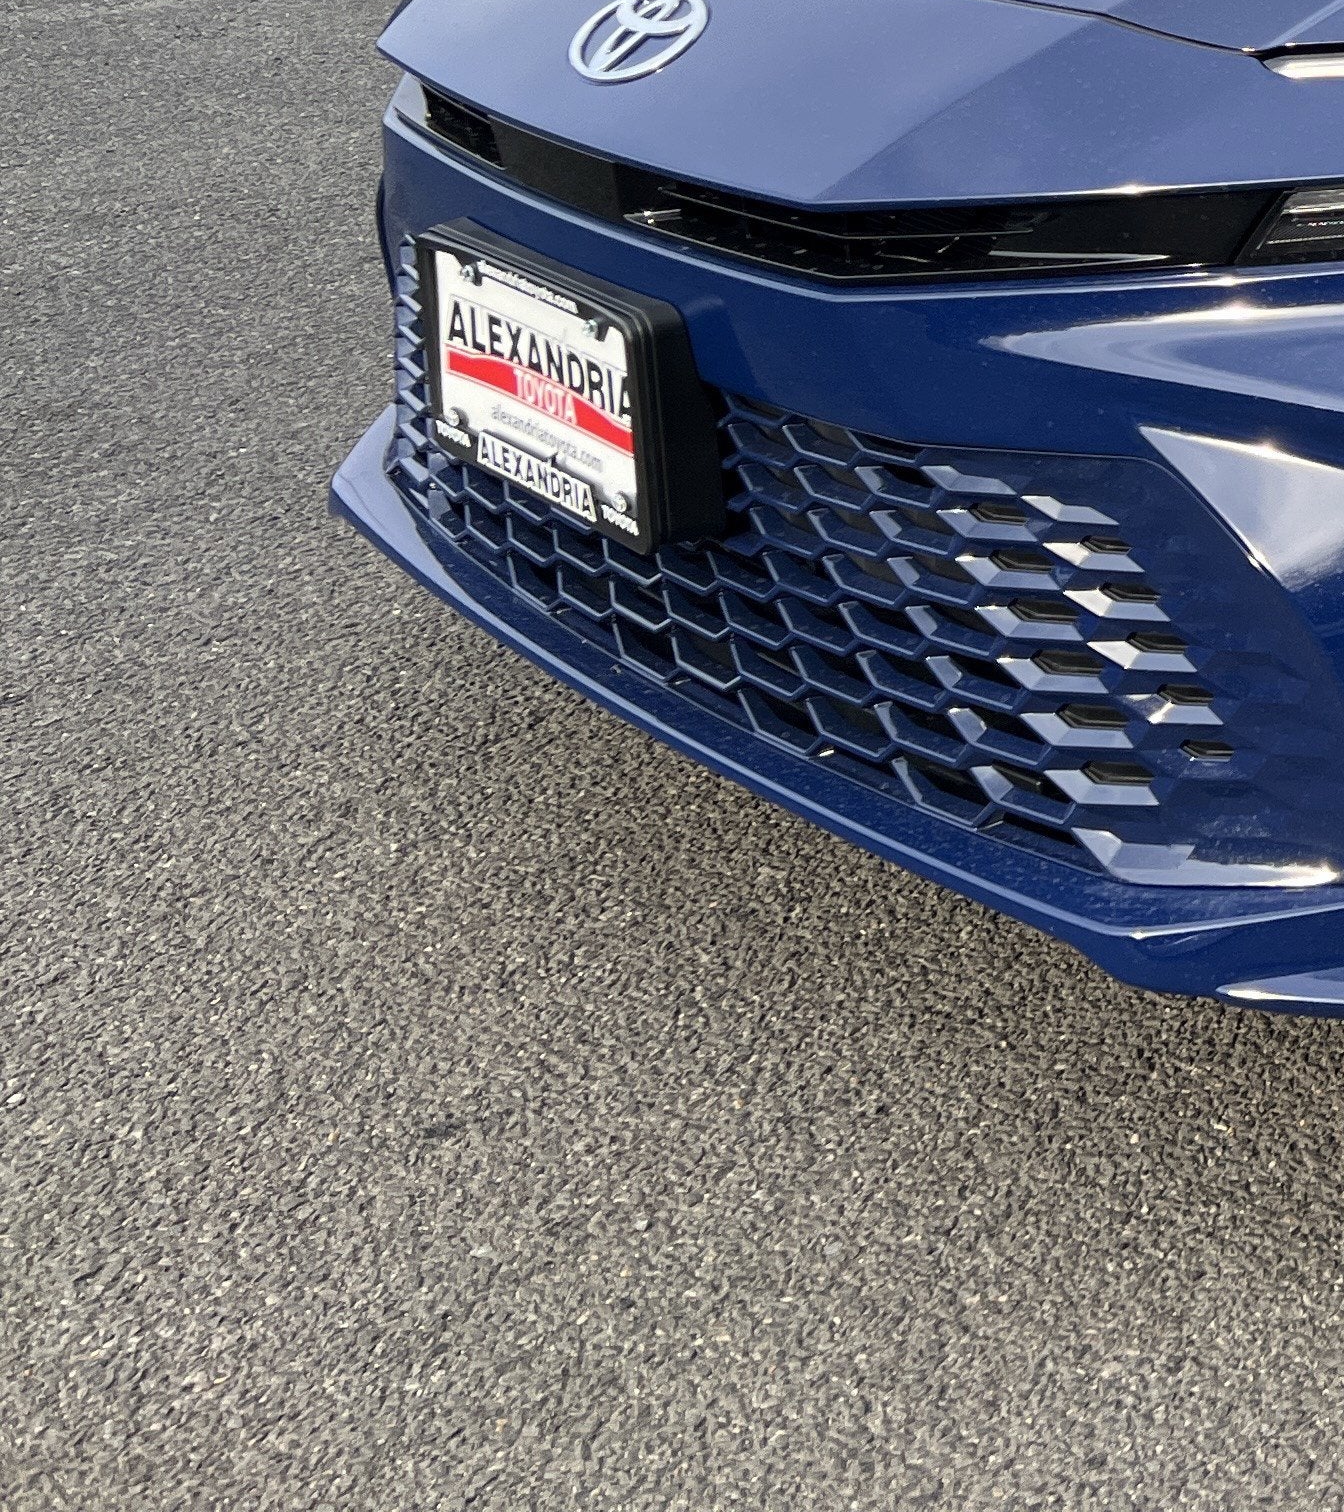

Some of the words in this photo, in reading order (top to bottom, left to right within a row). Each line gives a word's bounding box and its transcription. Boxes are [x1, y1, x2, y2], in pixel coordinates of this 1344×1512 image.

[448, 299, 631, 421] ALEXANDRIA
[512, 367, 579, 425] TOYOTA
[480, 435, 594, 517] ALEXANDRIA
